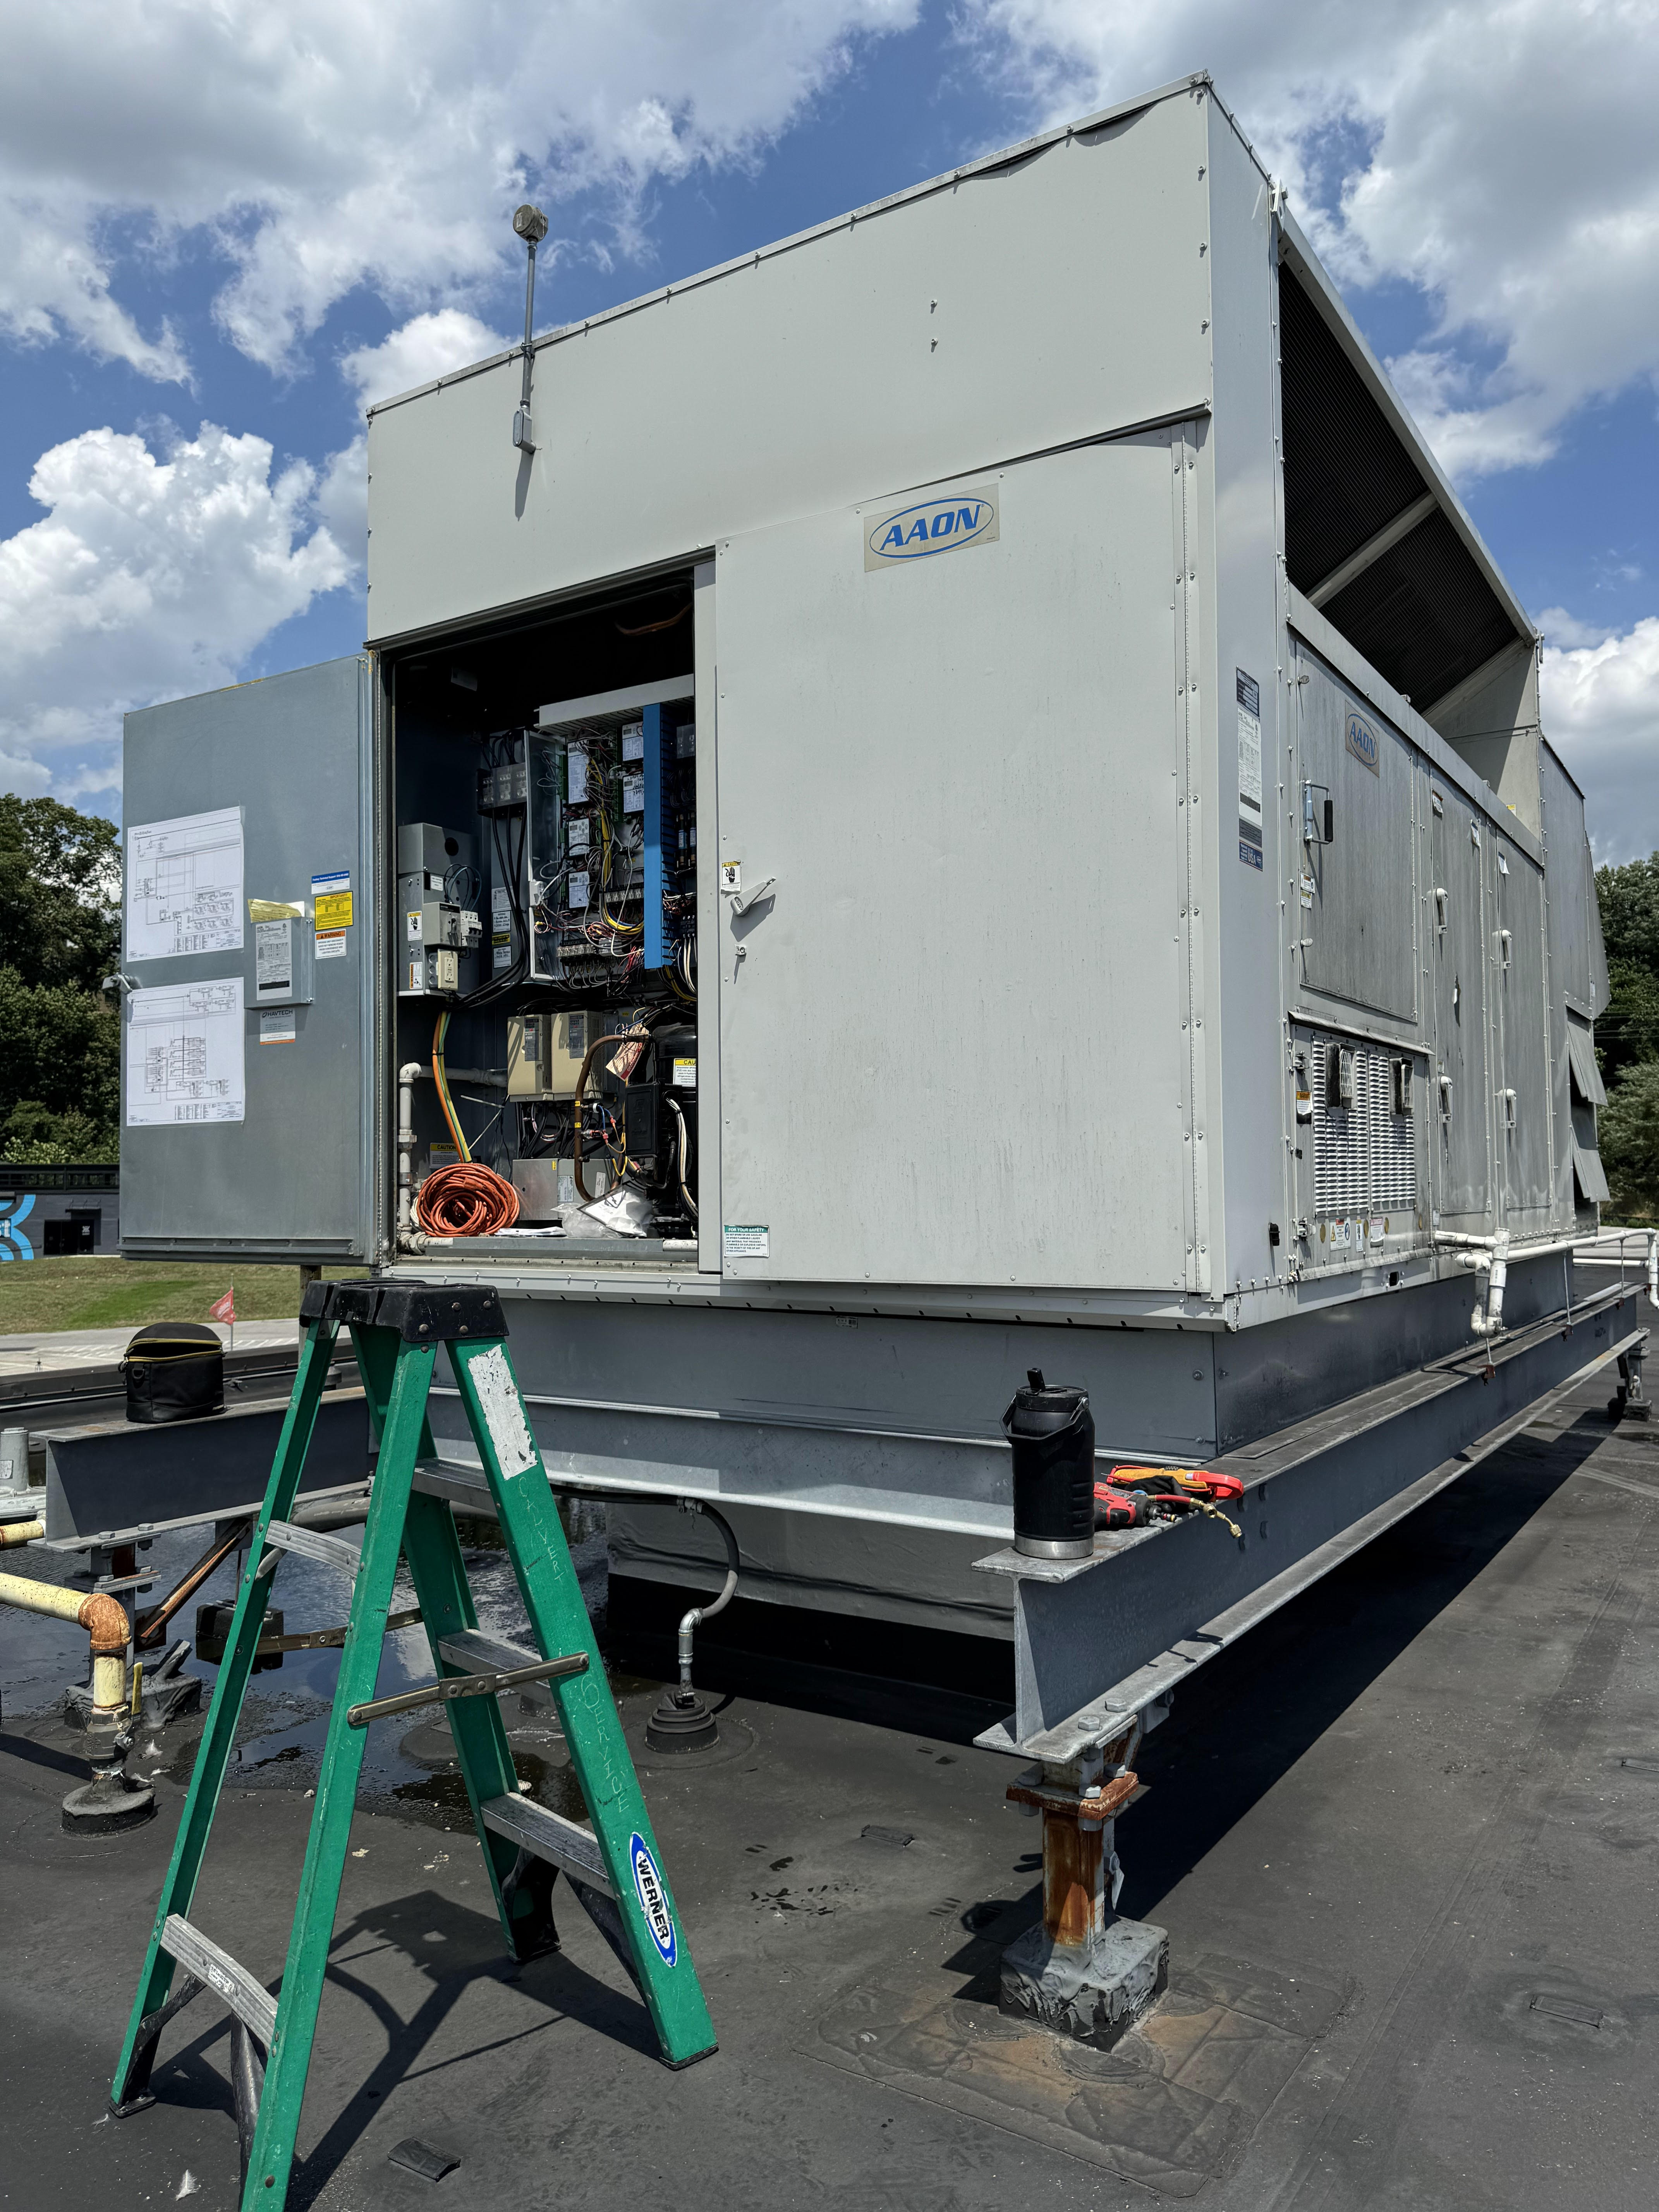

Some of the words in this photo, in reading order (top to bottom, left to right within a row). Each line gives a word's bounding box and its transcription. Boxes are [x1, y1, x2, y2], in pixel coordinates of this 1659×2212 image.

[879, 504, 981, 551] AAON
[1350, 721, 1376, 758] AAON
[519, 1477, 565, 1585] CALVERT
[581, 1674, 629, 1813] SERVICE
[637, 1856, 669, 1940] WERNER
